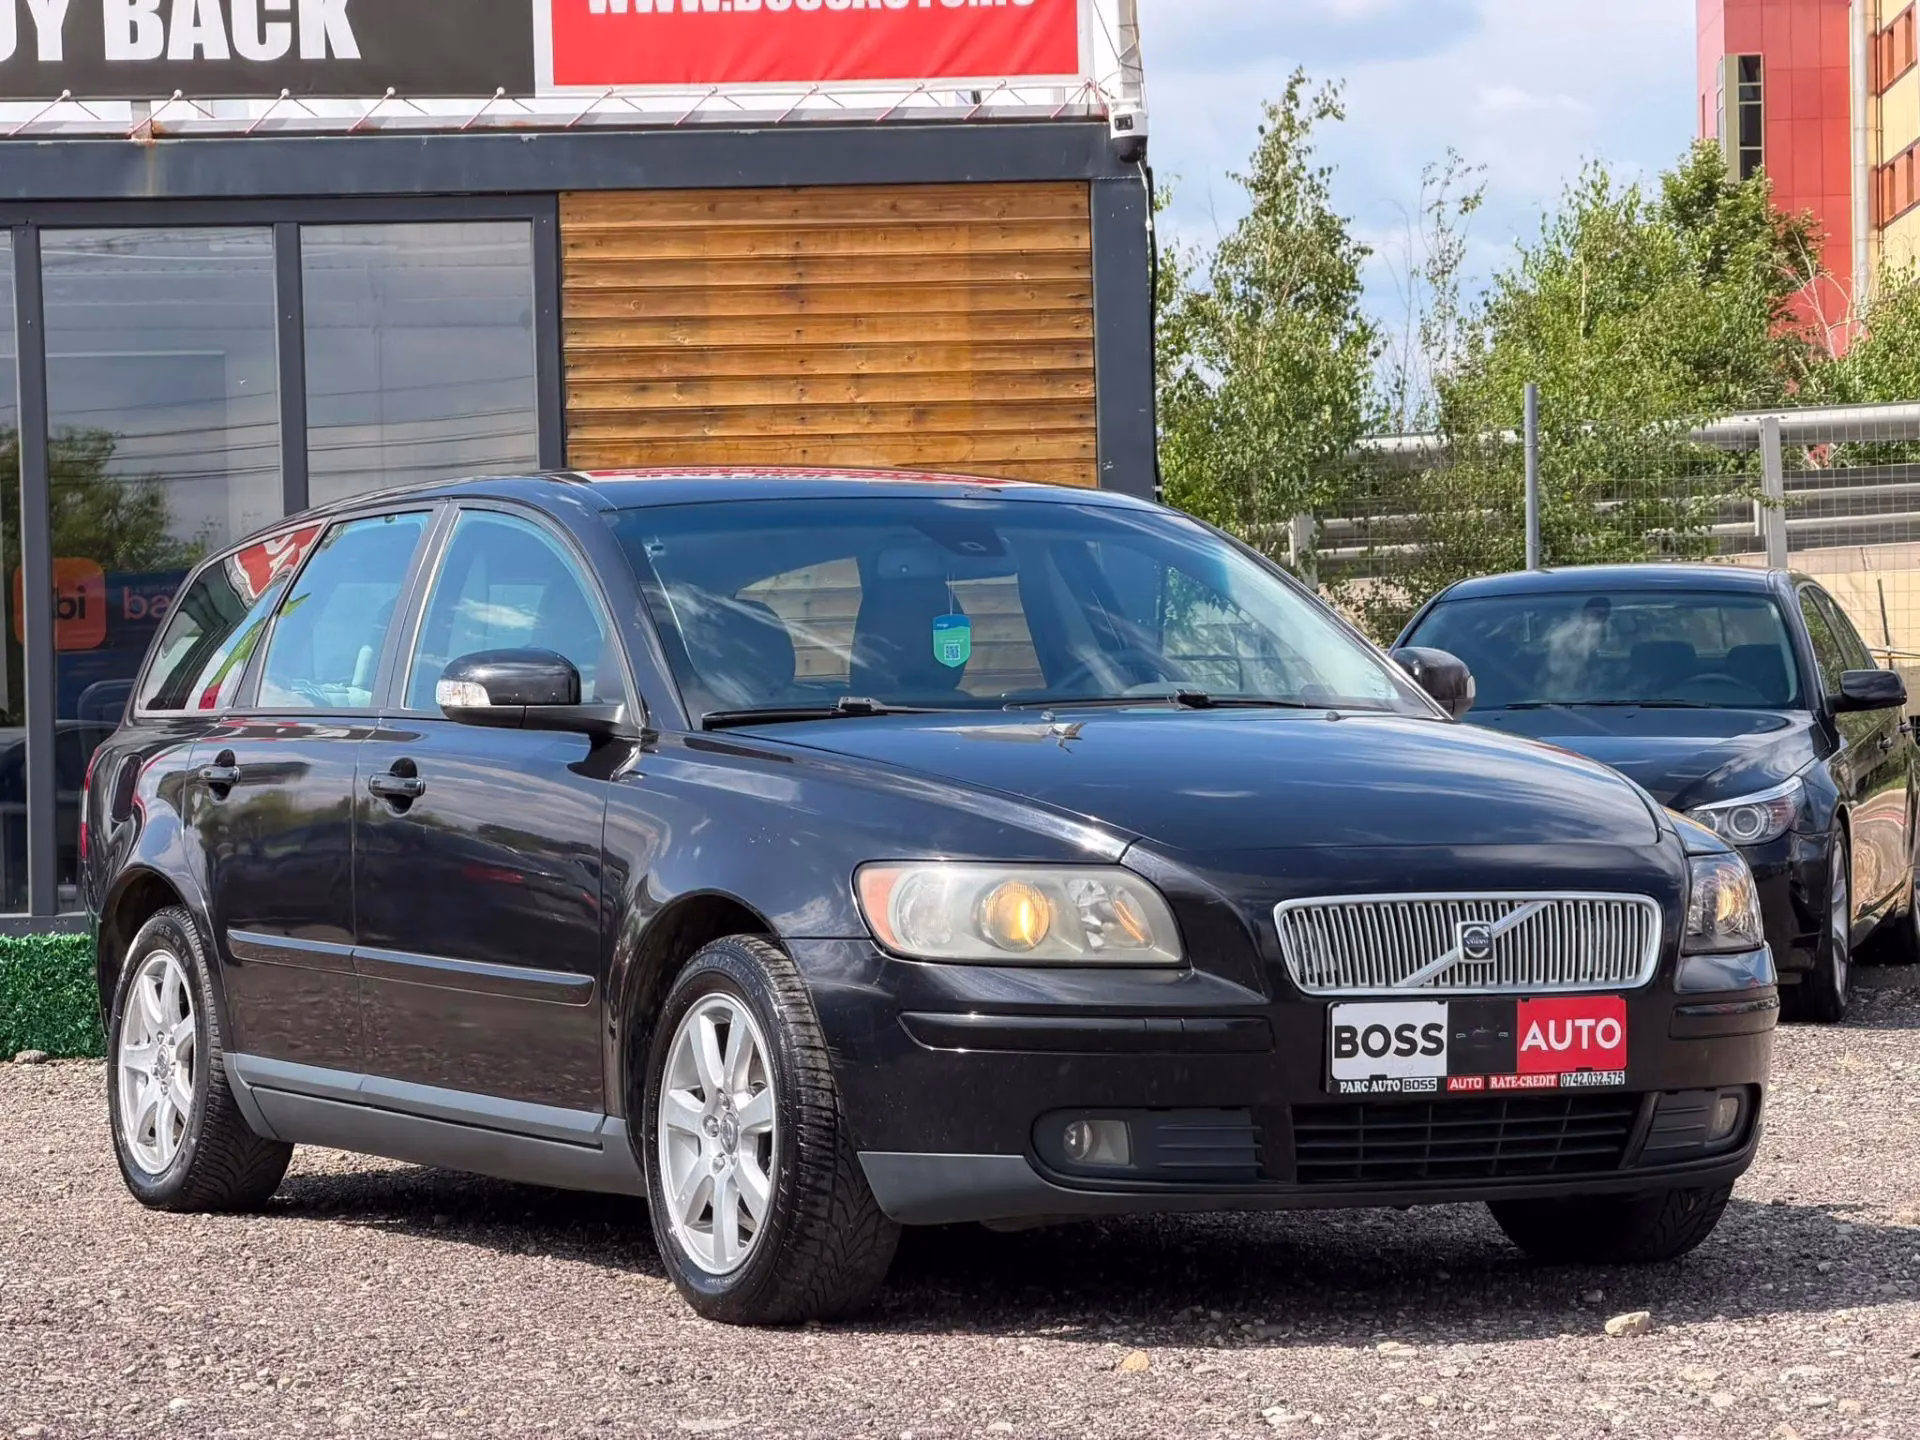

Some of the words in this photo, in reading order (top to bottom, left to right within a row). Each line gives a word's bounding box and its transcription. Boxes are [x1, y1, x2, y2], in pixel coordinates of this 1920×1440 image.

[0, 0, 69, 62] Y
[103, 0, 362, 61] BACK
[53, 585, 87, 620] bi
[1334, 1023, 1445, 1059] BOSS
[1520, 1018, 1622, 1051] AUTO
[1340, 1081, 1369, 1093] PARC
[1370, 1080, 1400, 1092] AUTO
[1404, 1078, 1436, 1091] BOSS
[1450, 1077, 1482, 1089] AUTO
[1491, 1075, 1557, 1089] RATE-CREDIT
